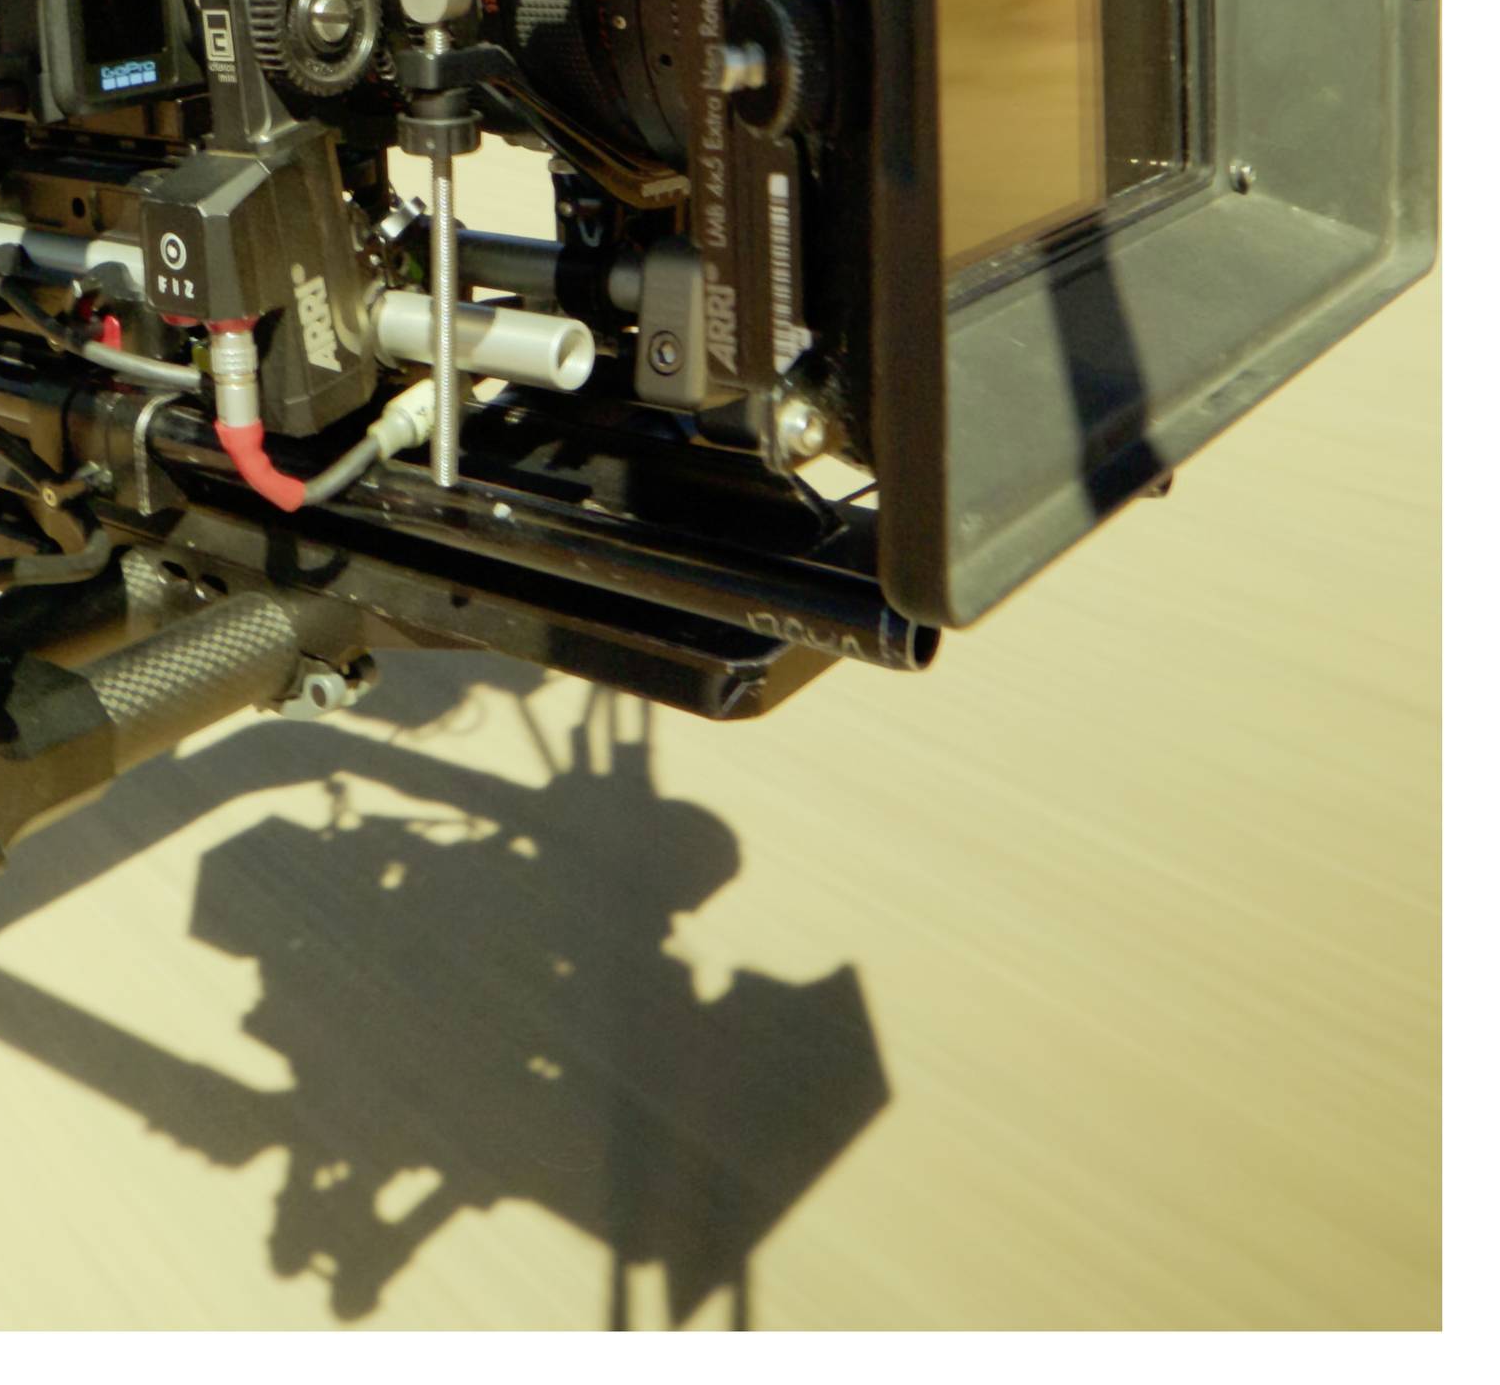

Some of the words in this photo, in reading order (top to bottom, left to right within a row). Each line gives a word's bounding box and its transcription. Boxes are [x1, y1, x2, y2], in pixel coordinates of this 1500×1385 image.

[100, 60, 157, 80] GoPro
[700, 96, 727, 152] Extra
[705, 204, 728, 249] LMB
[157, 274, 196, 300] FIZ
[293, 275, 343, 373] ARRI
